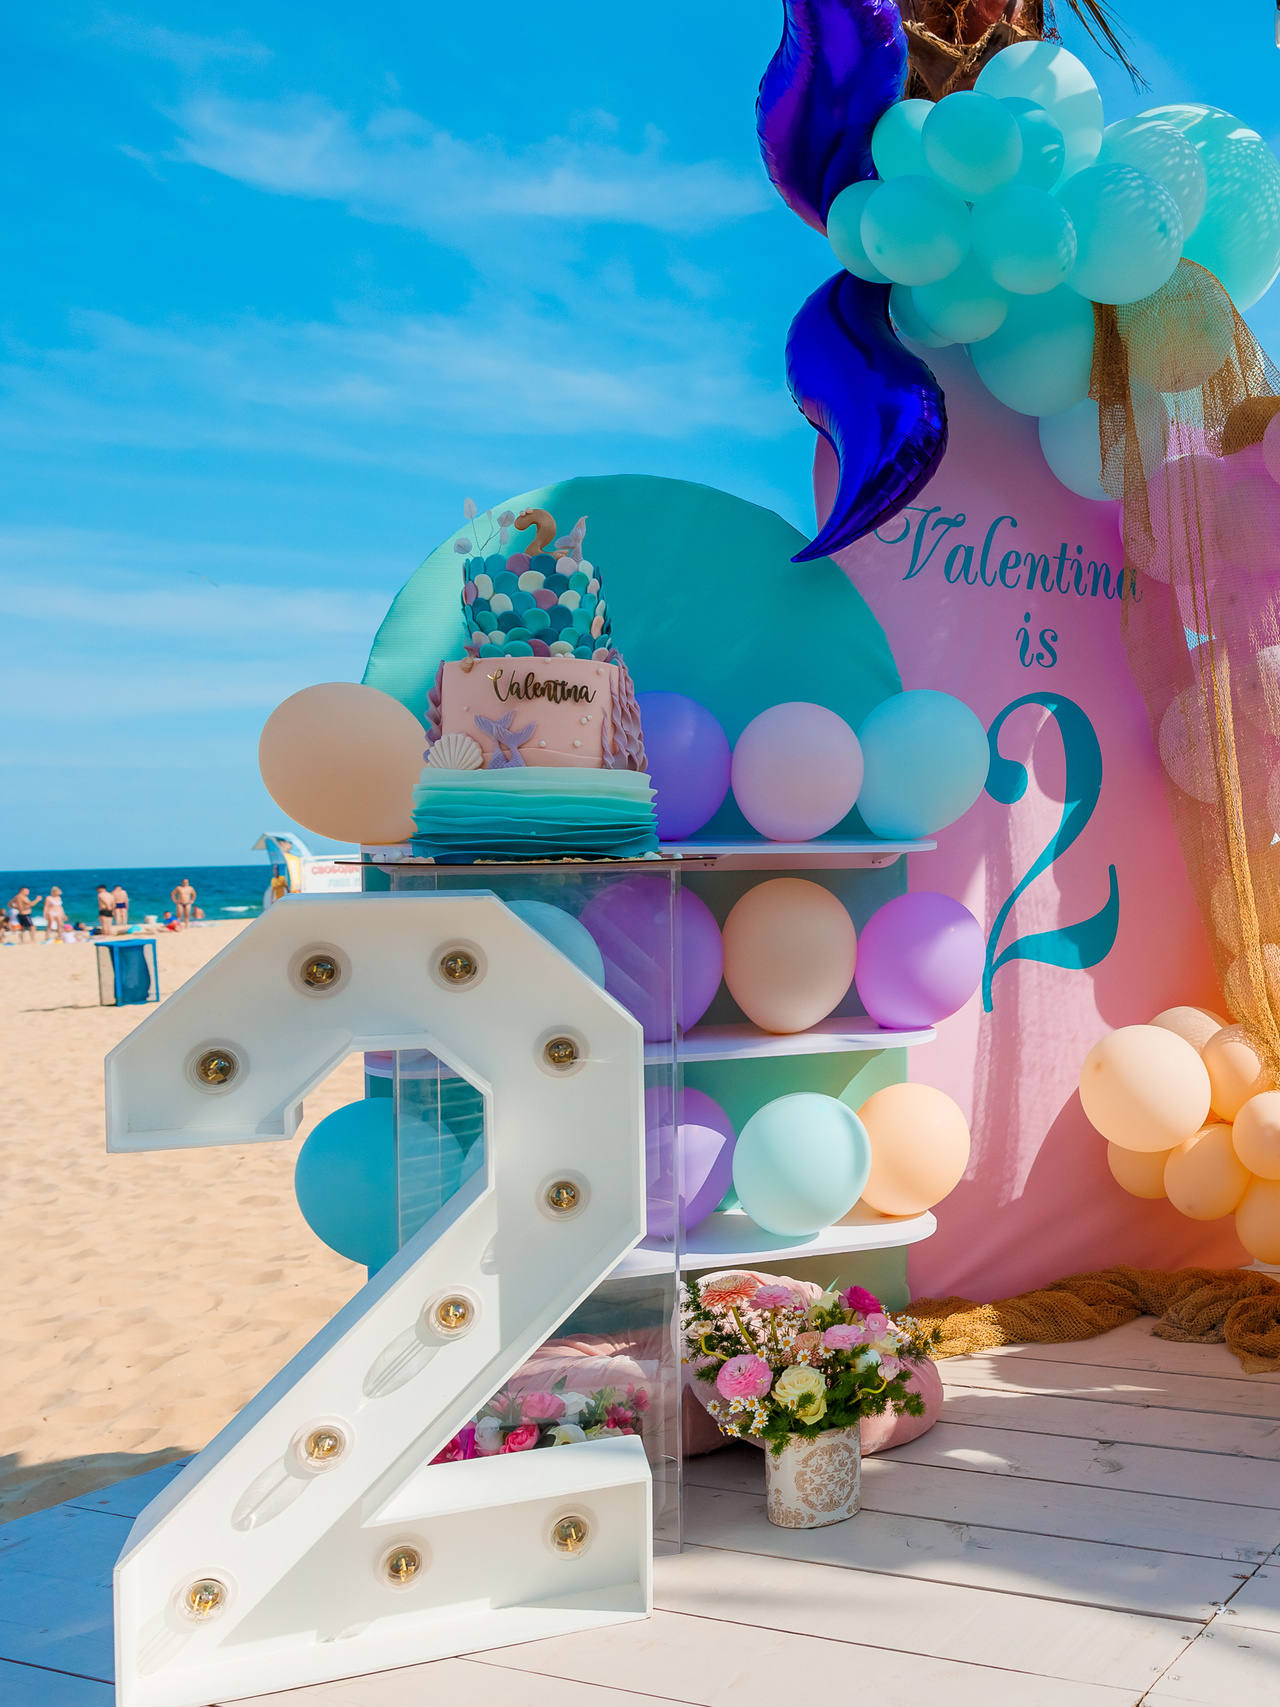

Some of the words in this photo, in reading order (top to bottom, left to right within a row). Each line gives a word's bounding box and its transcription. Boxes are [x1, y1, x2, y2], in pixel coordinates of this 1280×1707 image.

[514, 508, 569, 557] 2
[874, 506, 1142, 602] Valentina
[1016, 612, 1058, 668] is
[487, 668, 596, 704] Valentina
[982, 692, 1119, 1013] 2
